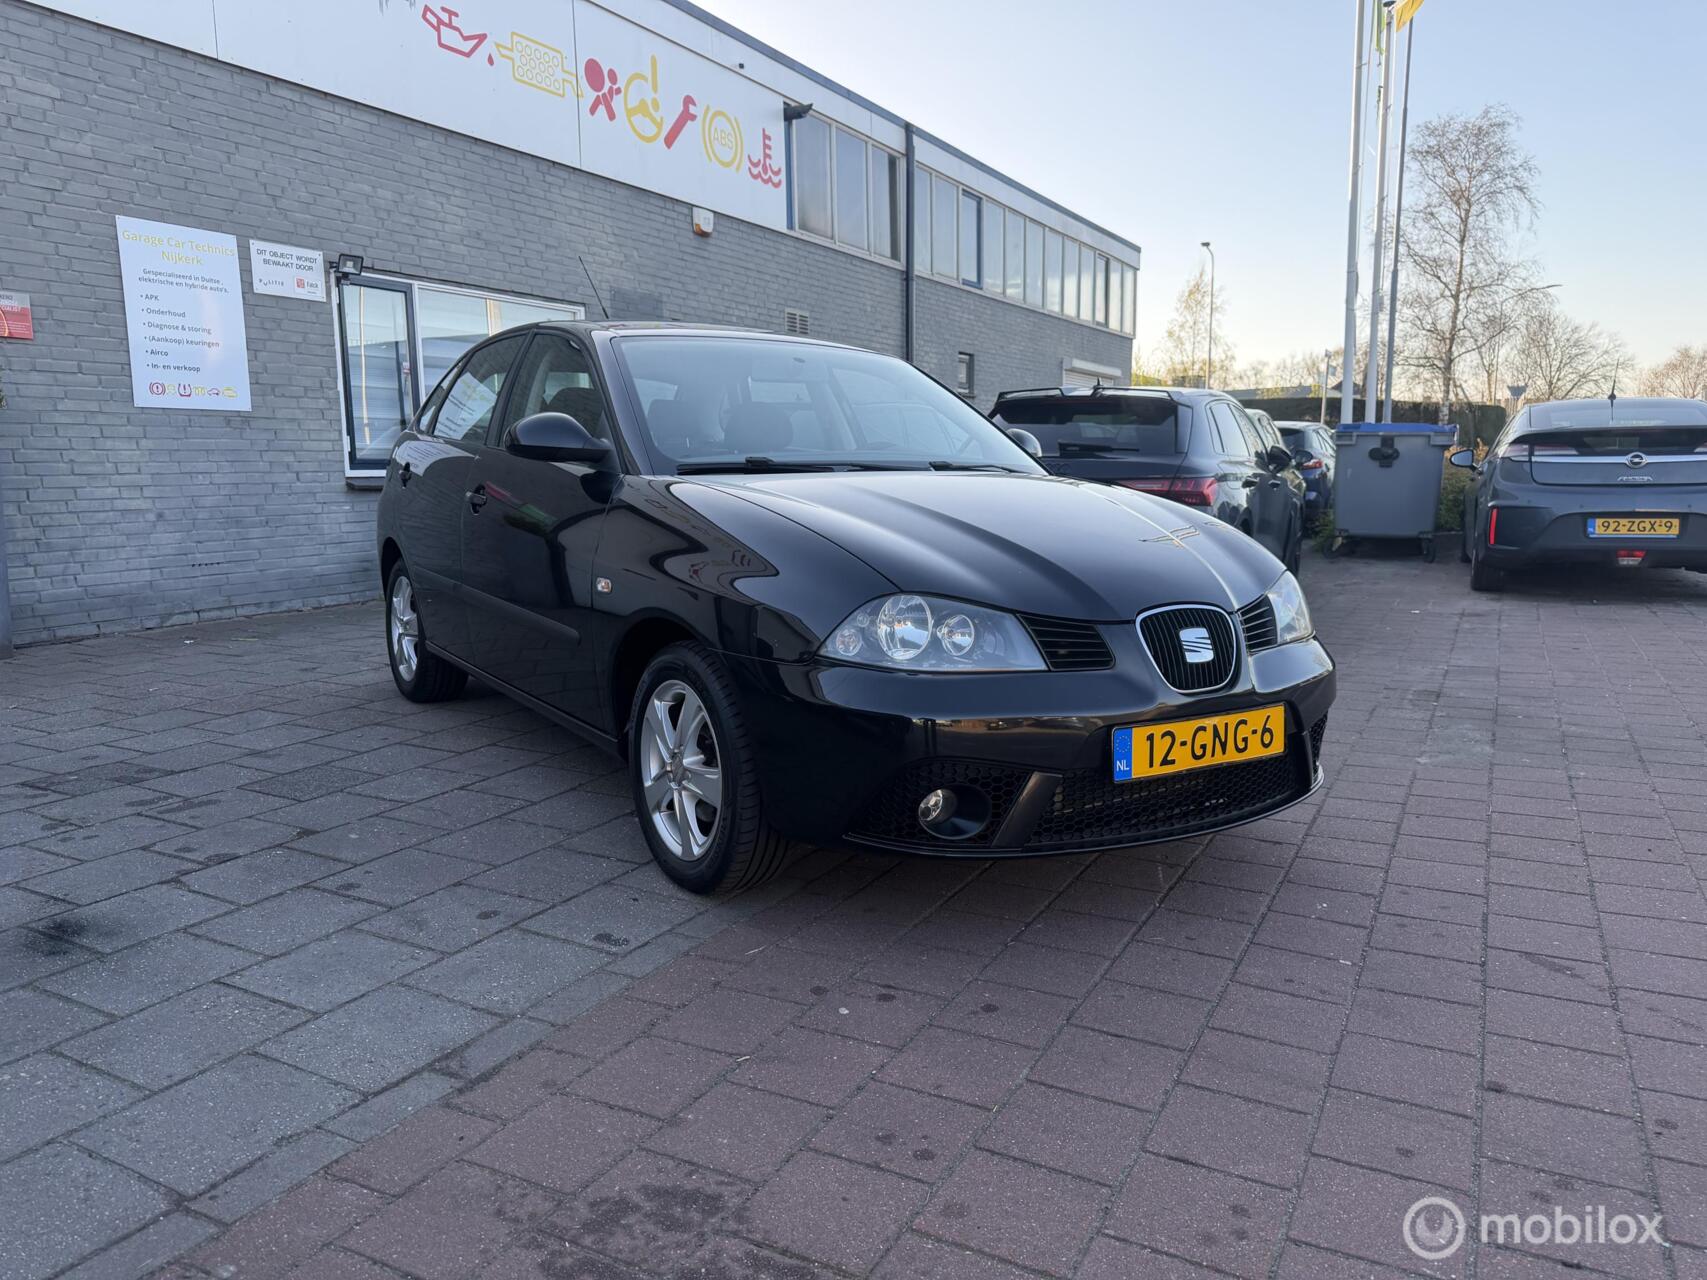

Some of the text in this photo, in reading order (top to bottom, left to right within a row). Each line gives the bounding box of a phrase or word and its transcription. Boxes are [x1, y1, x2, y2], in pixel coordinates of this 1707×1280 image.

[713, 127, 734, 150] ABS
[122, 230, 235, 256] Garage Car Technics
[161, 250, 203, 265] Nijkerk
[256, 248, 317, 264] DIT OBJECT WORDT
[263, 258, 314, 271] BEWAAKT DOOR
[138, 276, 174, 286] elektrische
[184, 281, 208, 291] hybride
[142, 268, 192, 281] Gespecialiseerd
[200, 276, 220, 285] Duitse
[146, 307, 186, 318] Onderhoud
[147, 321, 180, 332] Diagnose
[187, 325, 212, 335] storing
[148, 335, 220, 349] (Aankoop) keuringen
[150, 349, 169, 357] Airco
[172, 364, 201, 374] verkoop
[1601, 520, 1673, 533] 92-ZGX-9
[1146, 714, 1274, 769] 12-GNG-6
[1116, 760, 1130, 771] NL
